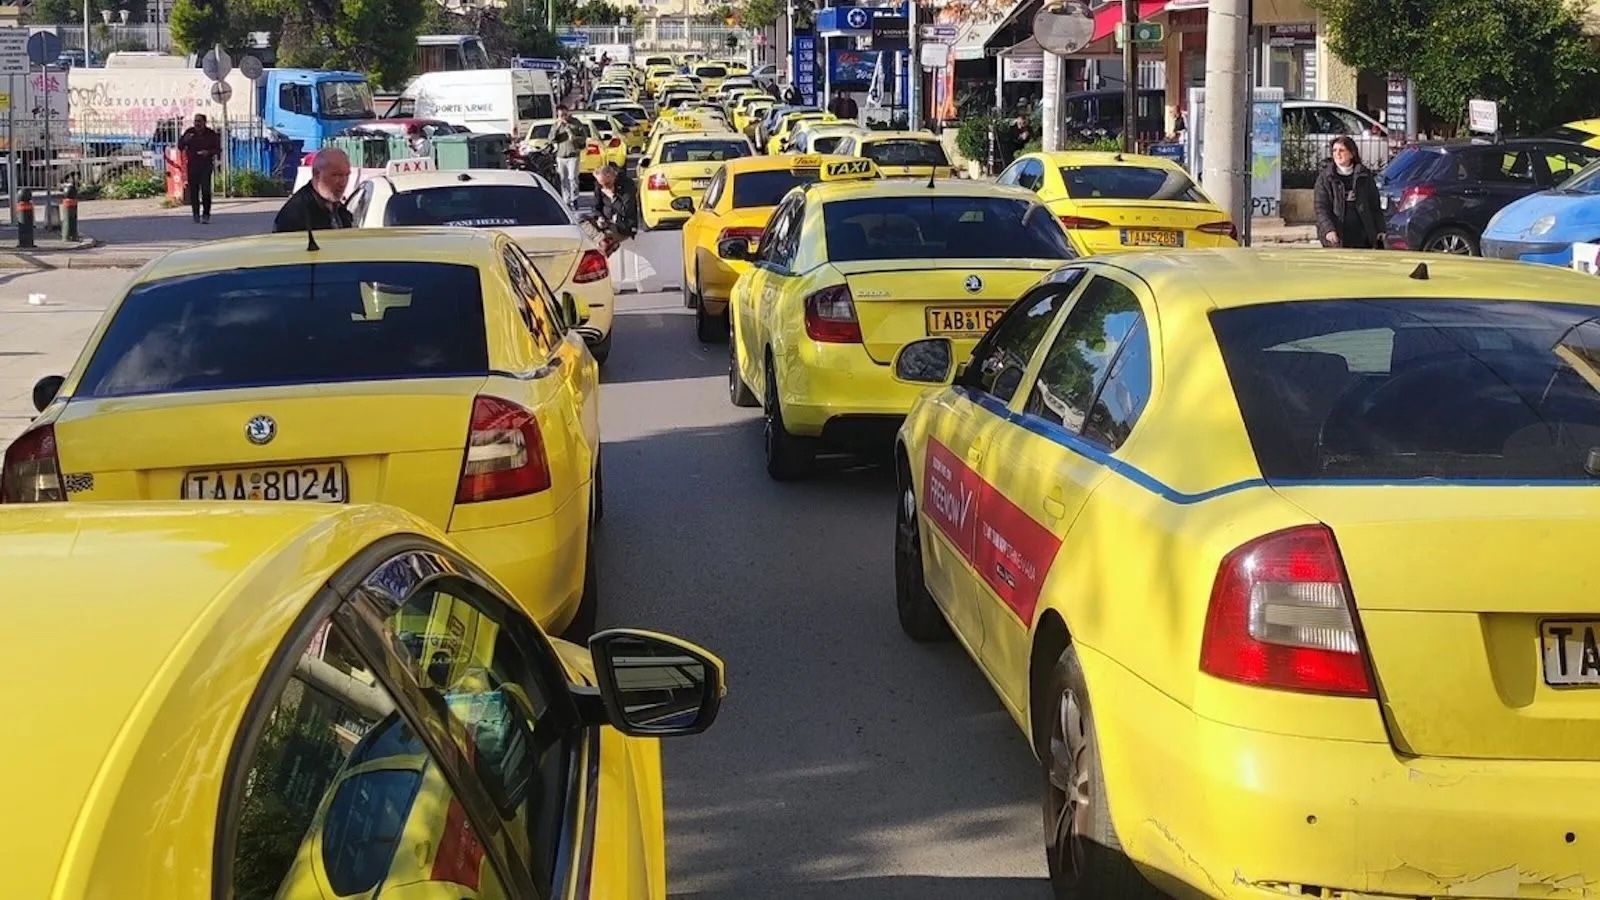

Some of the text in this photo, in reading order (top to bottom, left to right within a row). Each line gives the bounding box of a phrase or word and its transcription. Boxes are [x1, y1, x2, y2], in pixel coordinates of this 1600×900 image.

[394, 160, 429, 173] TAXI
[829, 161, 868, 176] TAXI
[447, 217, 515, 227] TAXI HELLAS
[193, 466, 339, 500] TAA-8024
